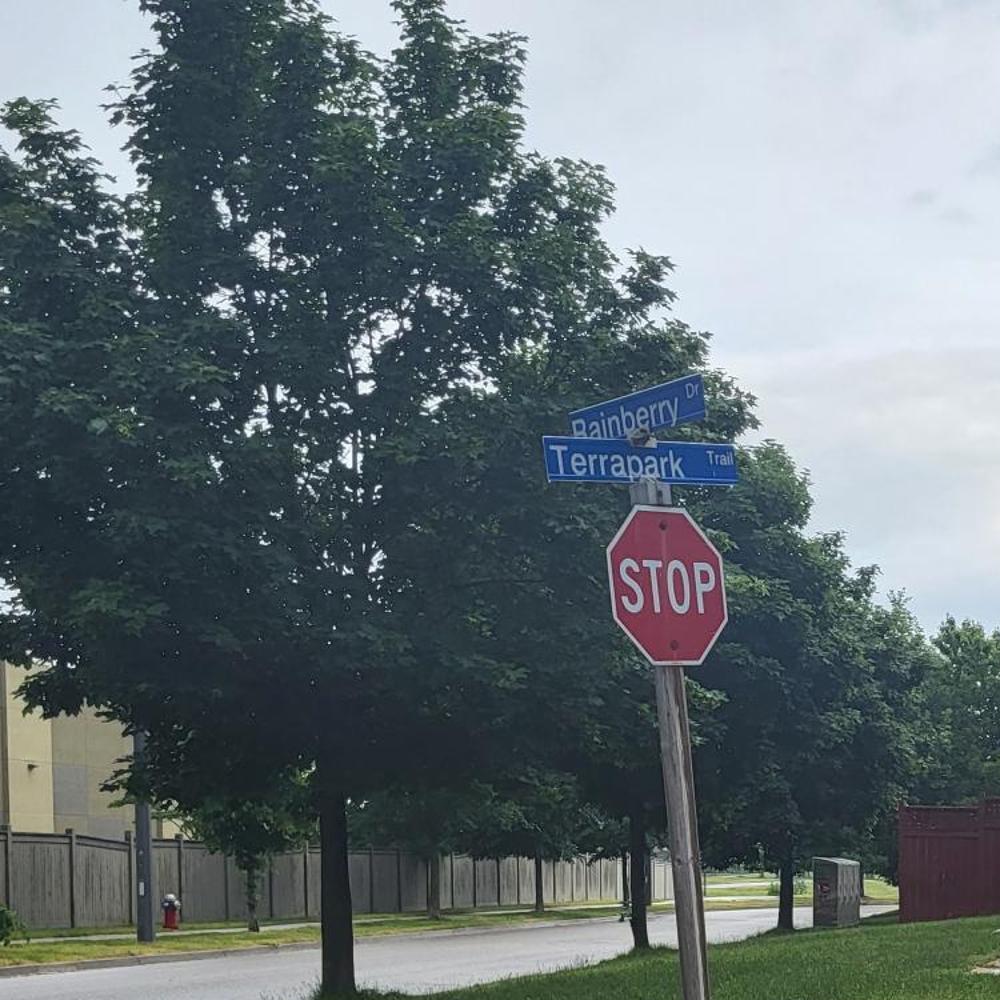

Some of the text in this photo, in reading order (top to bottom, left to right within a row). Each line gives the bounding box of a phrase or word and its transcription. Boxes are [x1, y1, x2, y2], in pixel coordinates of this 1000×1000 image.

[572, 383, 699, 438] Rainberry Dr
[549, 445, 734, 482] Terrapark Trail
[619, 558, 716, 614] STOP
